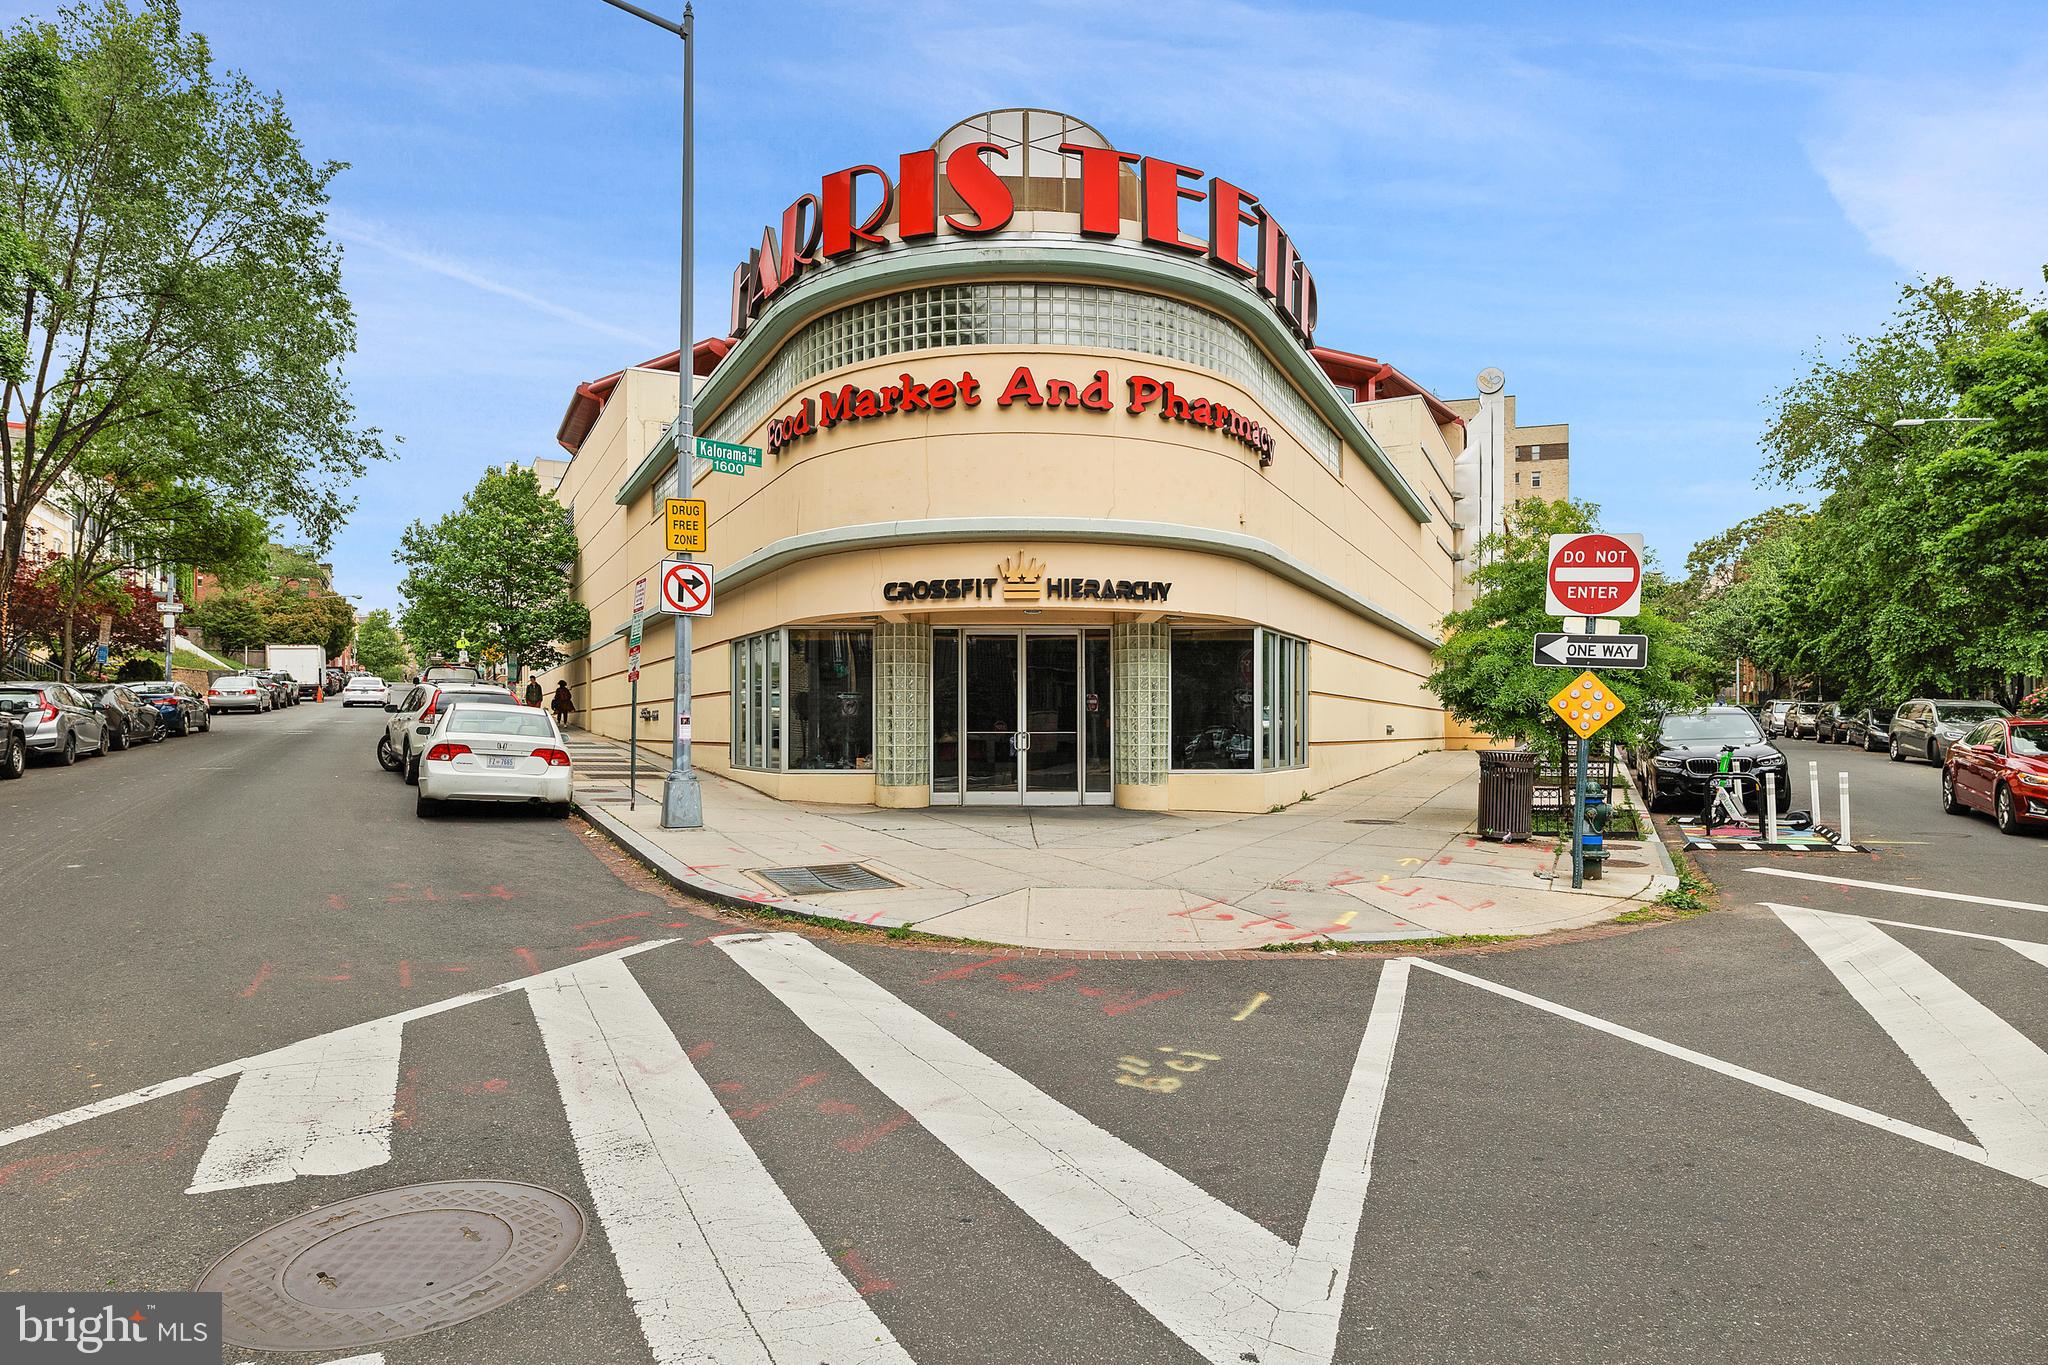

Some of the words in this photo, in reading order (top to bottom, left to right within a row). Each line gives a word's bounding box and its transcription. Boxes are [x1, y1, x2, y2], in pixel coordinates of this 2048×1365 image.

[729, 142, 1014, 338] HARRIS
[767, 397, 817, 454] Food
[819, 371, 981, 428] Market
[997, 367, 1113, 412] And
[1126, 375, 1276, 468] Pharmacy
[700, 441, 747, 462] Kalorama
[713, 460, 744, 475] 1600
[671, 504, 700, 516] DRUG
[672, 520, 699, 531] FREE
[673, 534, 699, 546] ZONE
[1564, 551, 1585, 563] DO
[1596, 550, 1628, 563] NOT
[883, 577, 998, 602] CROSSFIT
[1046, 578, 1172, 602] HIERARCHY
[1567, 586, 1619, 599] ENTER
[1567, 644, 1596, 657] ONE
[1603, 645, 1634, 658] WAY
